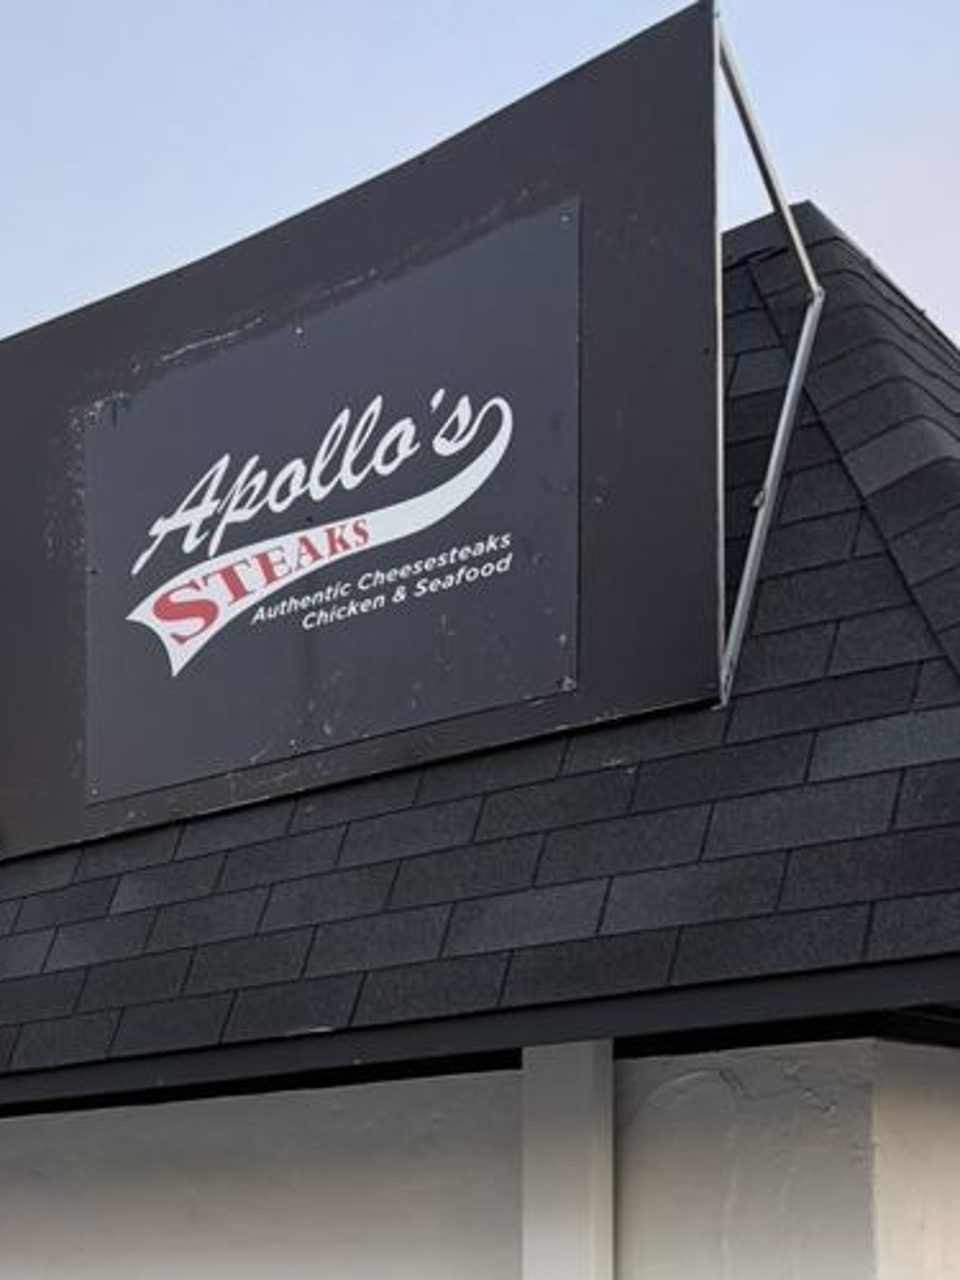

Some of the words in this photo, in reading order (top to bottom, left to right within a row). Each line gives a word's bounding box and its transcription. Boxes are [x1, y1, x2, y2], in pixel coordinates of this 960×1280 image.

[131, 388, 484, 576] Apollo's
[151, 517, 371, 645] STEAKS
[250, 579, 351, 625] Authentic
[357, 531, 513, 591] Cheesesteaks
[301, 593, 386, 630] Chicken
[391, 585, 408, 604] &
[413, 551, 514, 598] Seafood
